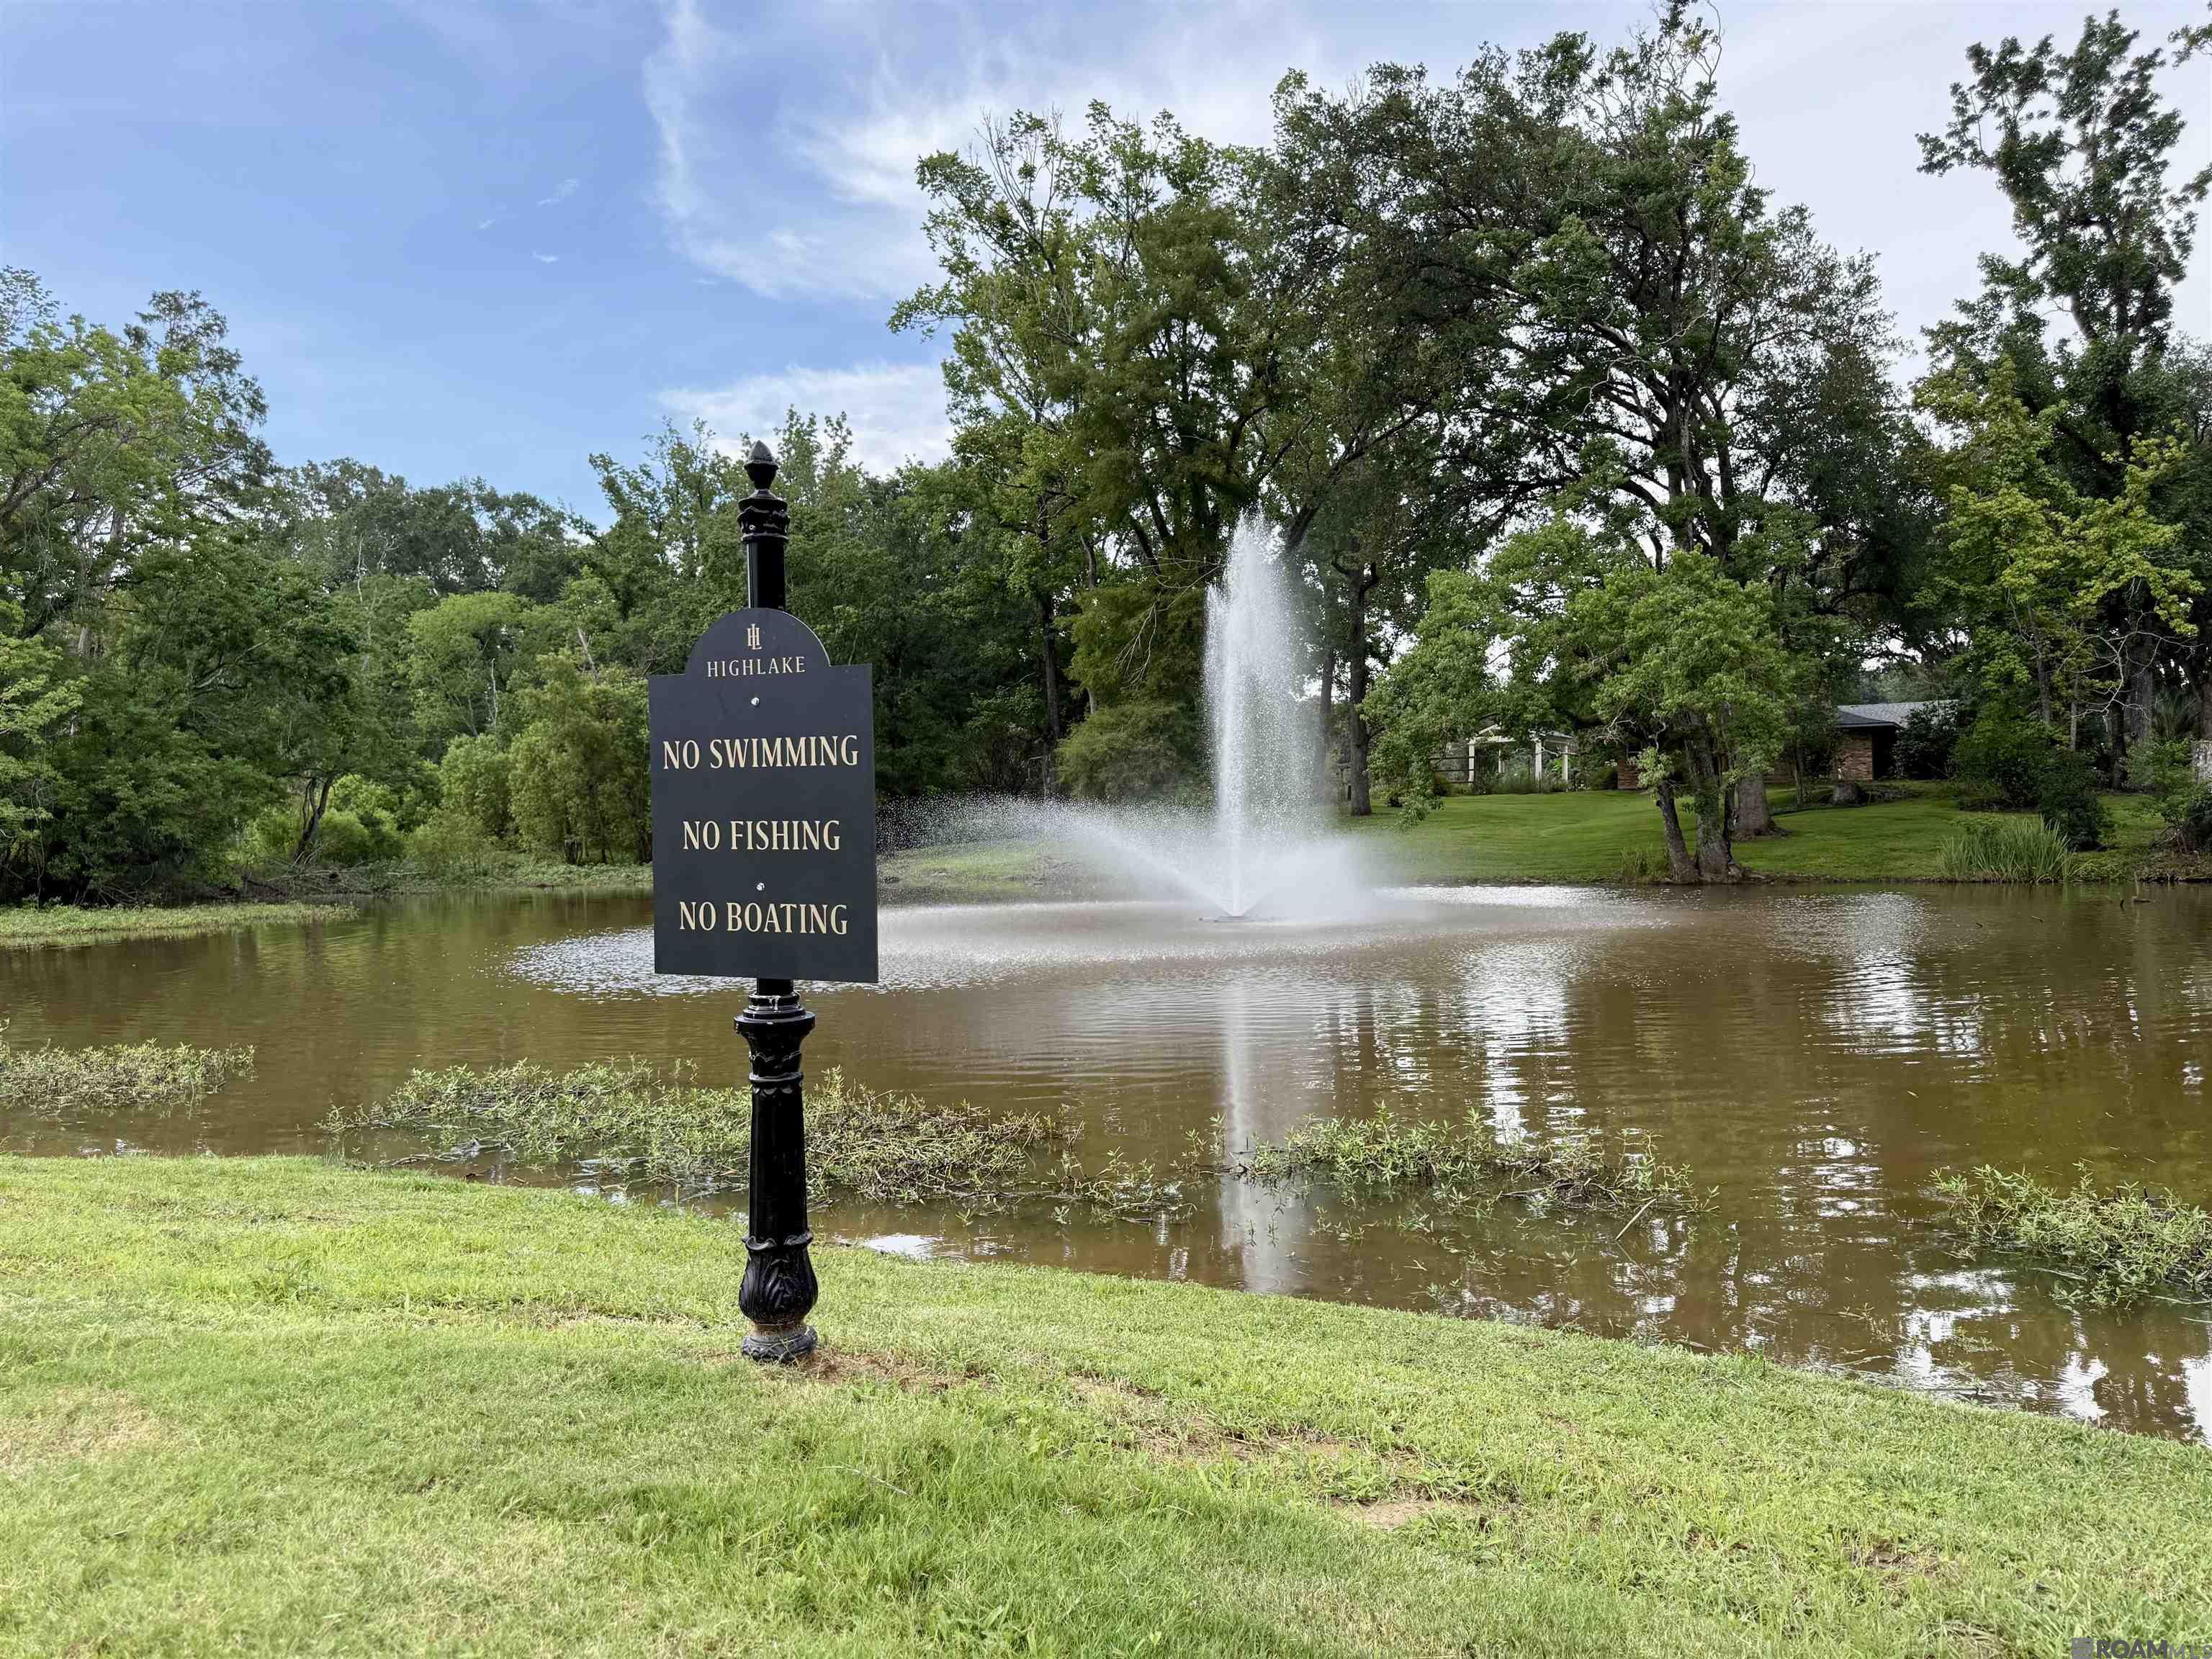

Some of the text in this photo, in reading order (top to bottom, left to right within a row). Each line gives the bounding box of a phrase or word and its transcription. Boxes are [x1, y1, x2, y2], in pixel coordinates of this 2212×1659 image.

[707, 656, 806, 678] HIGHLAKE
[662, 734, 858, 770] NO SWIMMING
[683, 819, 840, 850] NO FISHING
[679, 901, 848, 935] NO BOATING
